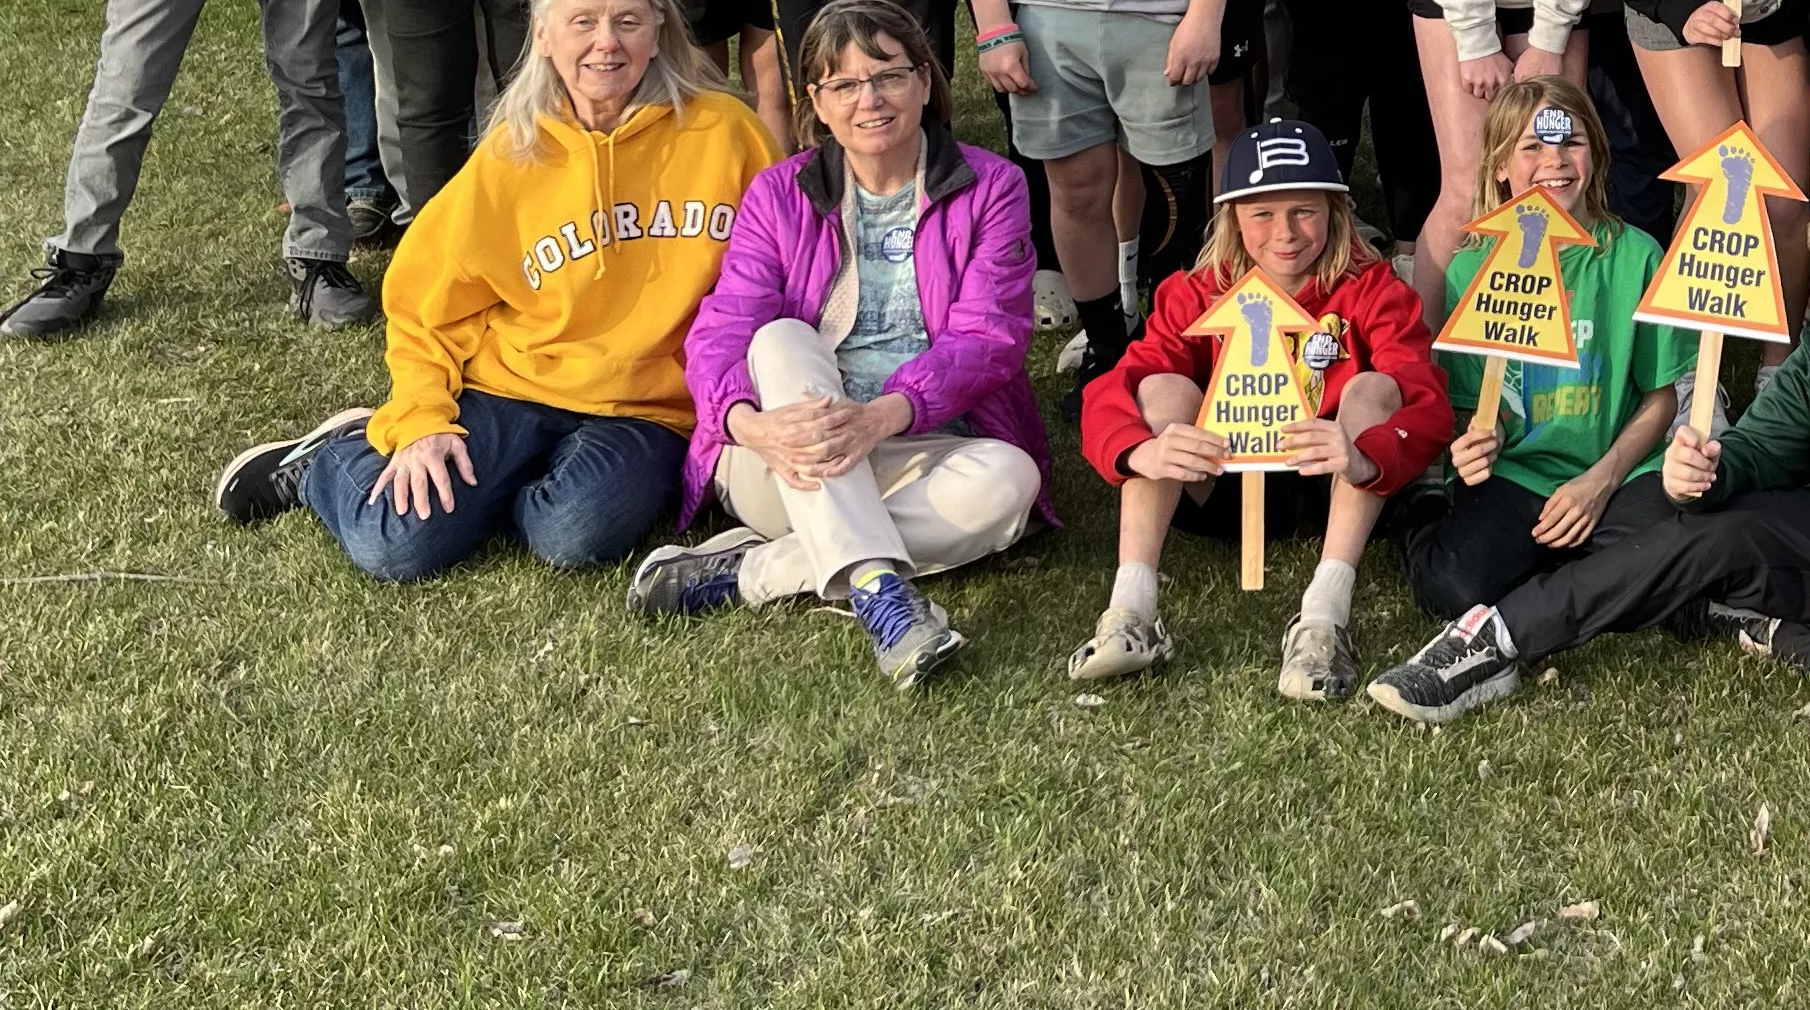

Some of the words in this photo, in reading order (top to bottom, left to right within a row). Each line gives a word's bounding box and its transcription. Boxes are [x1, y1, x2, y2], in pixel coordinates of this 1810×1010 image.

[1536, 116, 1567, 130] HUNGER
[1543, 109, 1565, 118] END
[522, 200, 735, 290] COLORADO
[884, 236, 913, 249] HUNGE
[1692, 227, 1760, 258] CROP
[1678, 252, 1766, 288] Hunger
[1489, 271, 1552, 296] CROP
[1475, 292, 1557, 321] Hunger
[1687, 286, 1748, 319] Walk
[1313, 334, 1333, 343] END
[1484, 321, 1540, 347] Walk
[1304, 341, 1339, 356] HUNGER
[1226, 372, 1290, 396] CROP
[1216, 401, 1300, 426] Hunger
[1229, 431, 1287, 455] Walk
